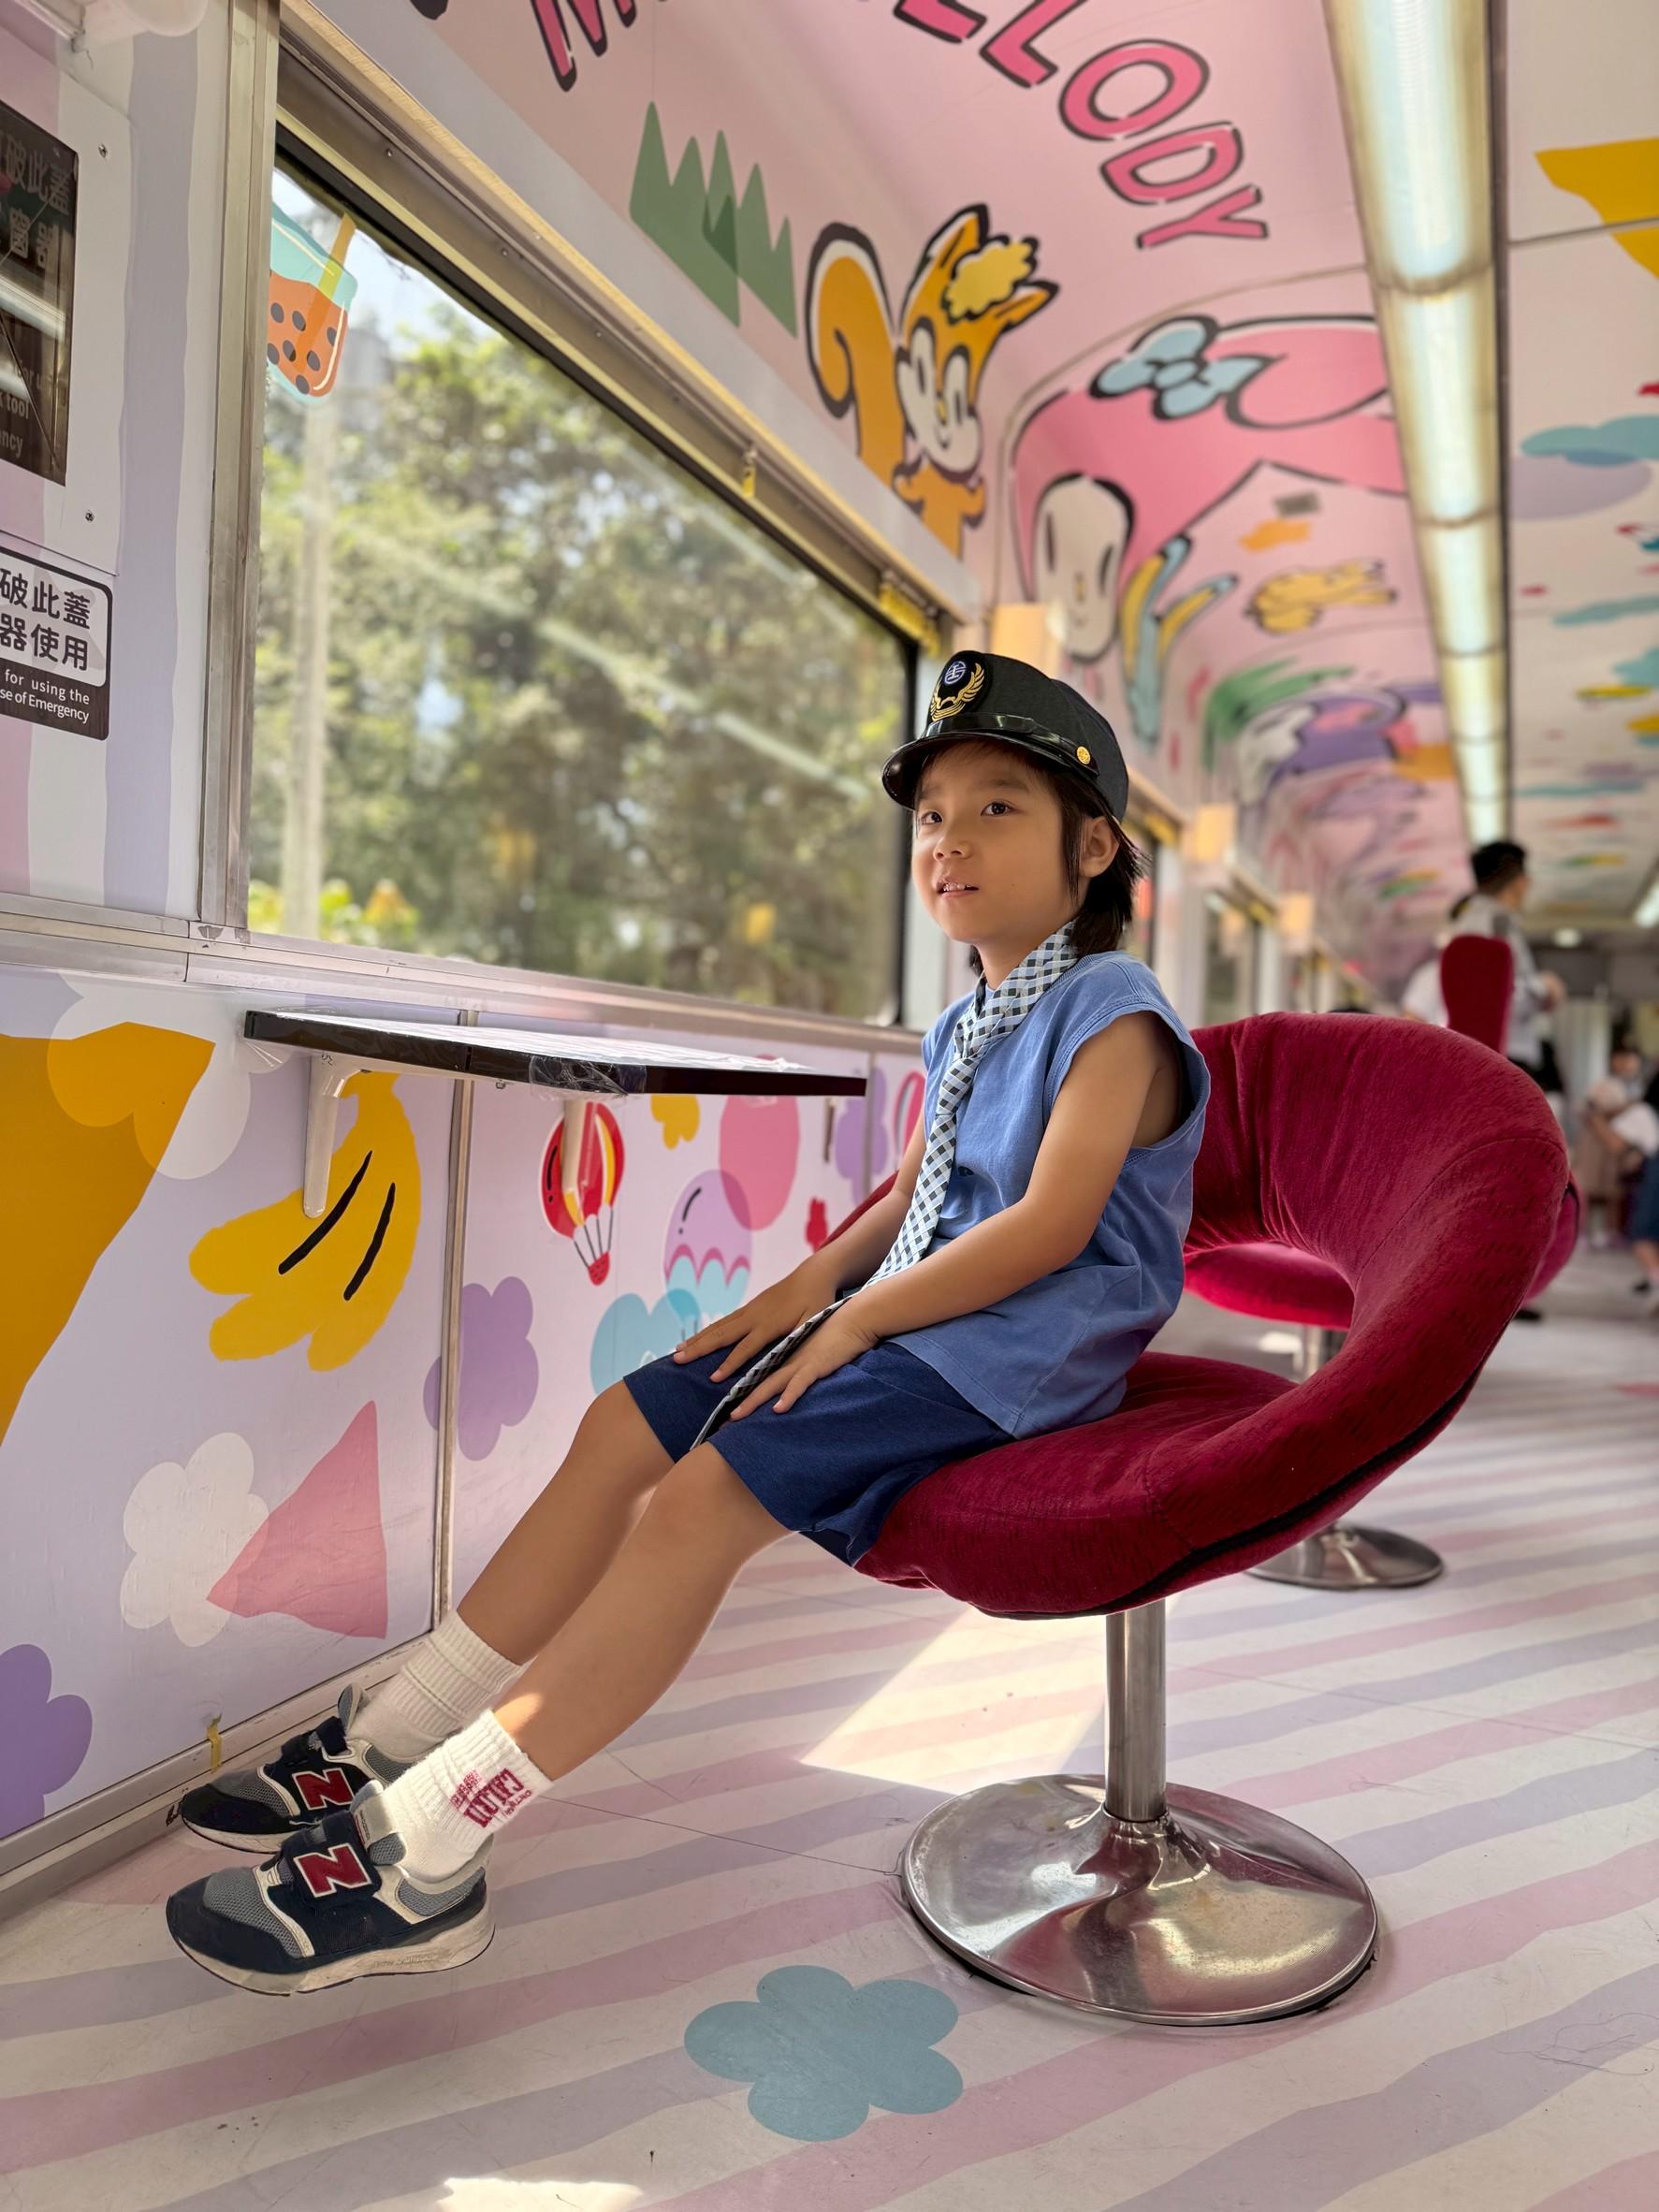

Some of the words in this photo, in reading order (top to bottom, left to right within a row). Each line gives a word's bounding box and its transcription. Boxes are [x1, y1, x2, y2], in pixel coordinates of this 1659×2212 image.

[894, 0, 1269, 250] LODY
[0, 132, 69, 216] 破此蓋
[0, 429, 23, 458] ncy
[0, 567, 91, 630] 破此蓋
[0, 612, 89, 671] 器使用
[5, 668, 25, 686] for
[31, 679, 66, 702] using
[69, 688, 91, 706] the
[14, 691, 27, 706] of
[28, 693, 90, 725] Emergency
[292, 1767, 356, 1811] N
[293, 1842, 372, 1899] N
